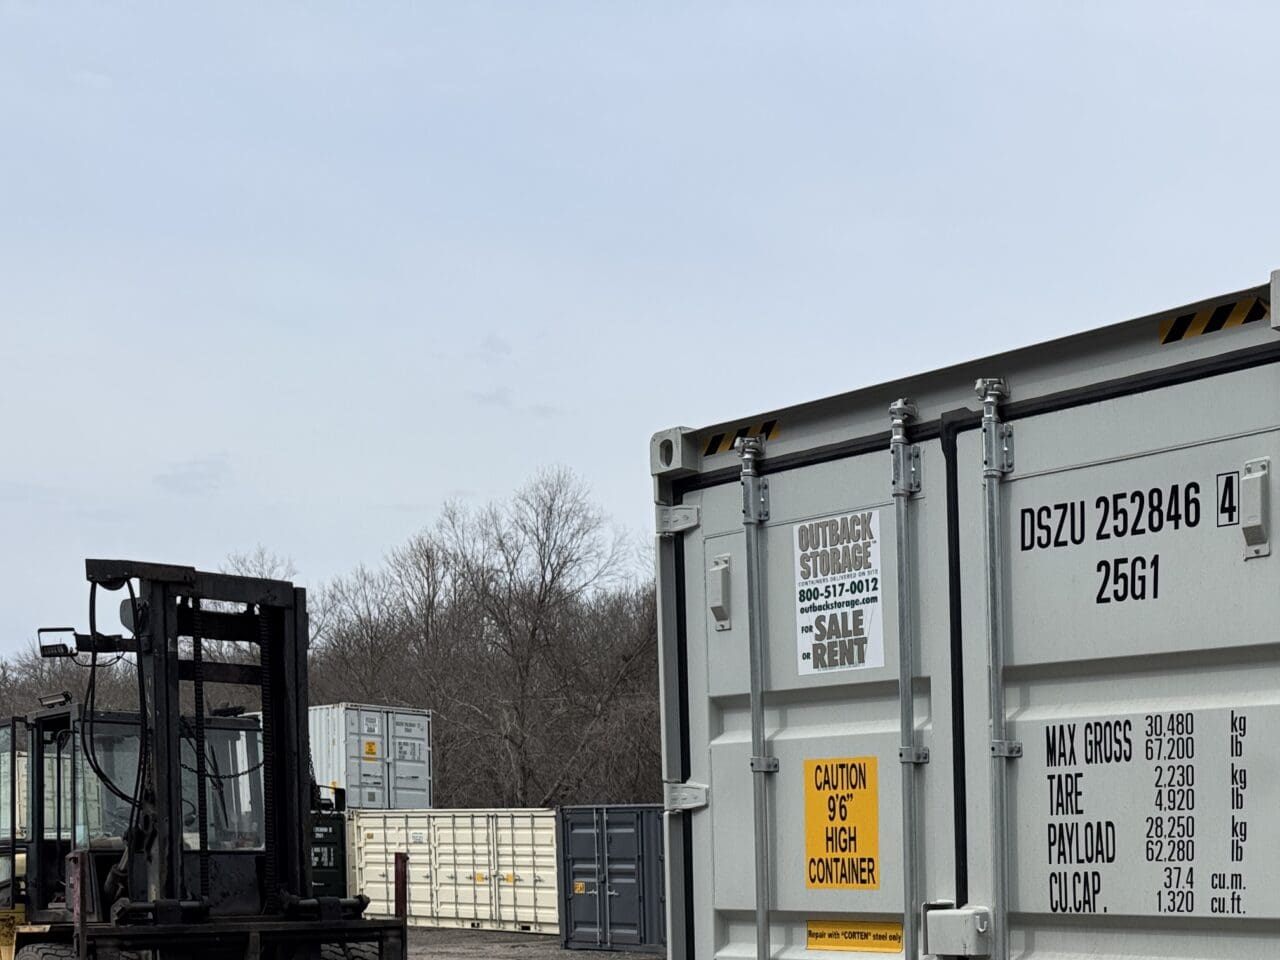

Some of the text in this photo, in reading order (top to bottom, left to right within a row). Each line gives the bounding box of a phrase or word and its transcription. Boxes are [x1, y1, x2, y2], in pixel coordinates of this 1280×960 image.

[1021, 476, 1236, 551] DSZU 252846 4
[798, 512, 874, 552] OUTBACK
[800, 541, 872, 580] STORAGE
[798, 577, 879, 603] 800-517-0012
[1096, 554, 1160, 604] 25G1
[800, 596, 878, 614] outbackstorage.com
[801, 609, 864, 642] FOR SALE
[802, 637, 867, 669] OR RENT
[1046, 723, 1076, 767] MAX
[1084, 719, 1132, 765] GROSS
[1230, 710, 1246, 737] kg
[1231, 734, 1243, 757] lb
[814, 763, 866, 791] CAUTION
[1047, 773, 1084, 816] TARE
[1231, 763, 1247, 790] kg
[1231, 787, 1243, 810] lb
[825, 827, 857, 853] HIGH
[1048, 821, 1116, 864] PAYLOAD
[1231, 815, 1247, 842] kg
[1231, 839, 1243, 862] lb
[808, 857, 876, 885] CONTAINER
[1164, 867, 1194, 889] 37.4
[1211, 873, 1246, 890] cu.m.
[1156, 890, 1246, 914] 1,320 cu.ft.
[808, 930, 826, 940] Repair
[827, 931, 840, 939] with
[872, 932, 887, 940] steel
[889, 933, 902, 943] only
